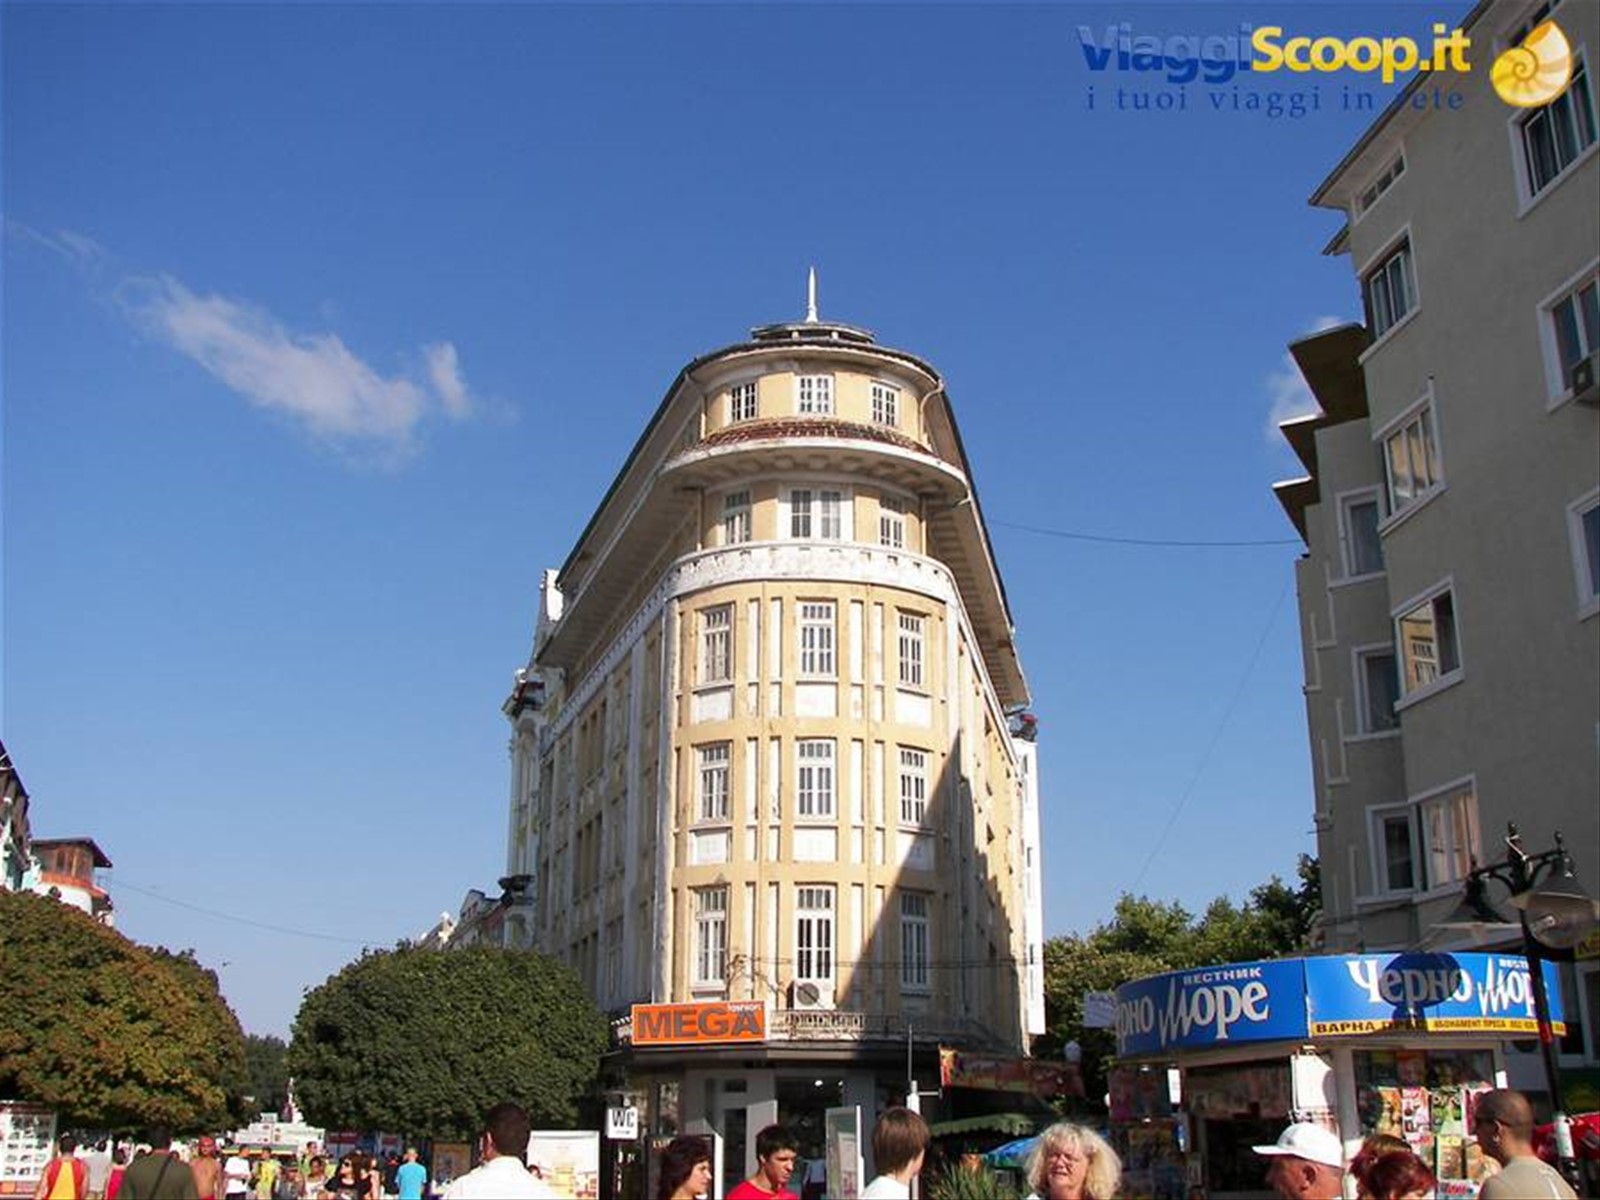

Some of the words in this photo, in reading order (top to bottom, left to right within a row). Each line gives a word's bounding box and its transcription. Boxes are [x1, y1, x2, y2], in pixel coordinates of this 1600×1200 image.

[1184, 967, 1262, 985] ВЕСТНИК
[1346, 959, 1473, 1016] Черно
[638, 1006, 761, 1039] MEGA
[1316, 1021, 1376, 1034] ВАРНА
[612, 1109, 635, 1128] WC
